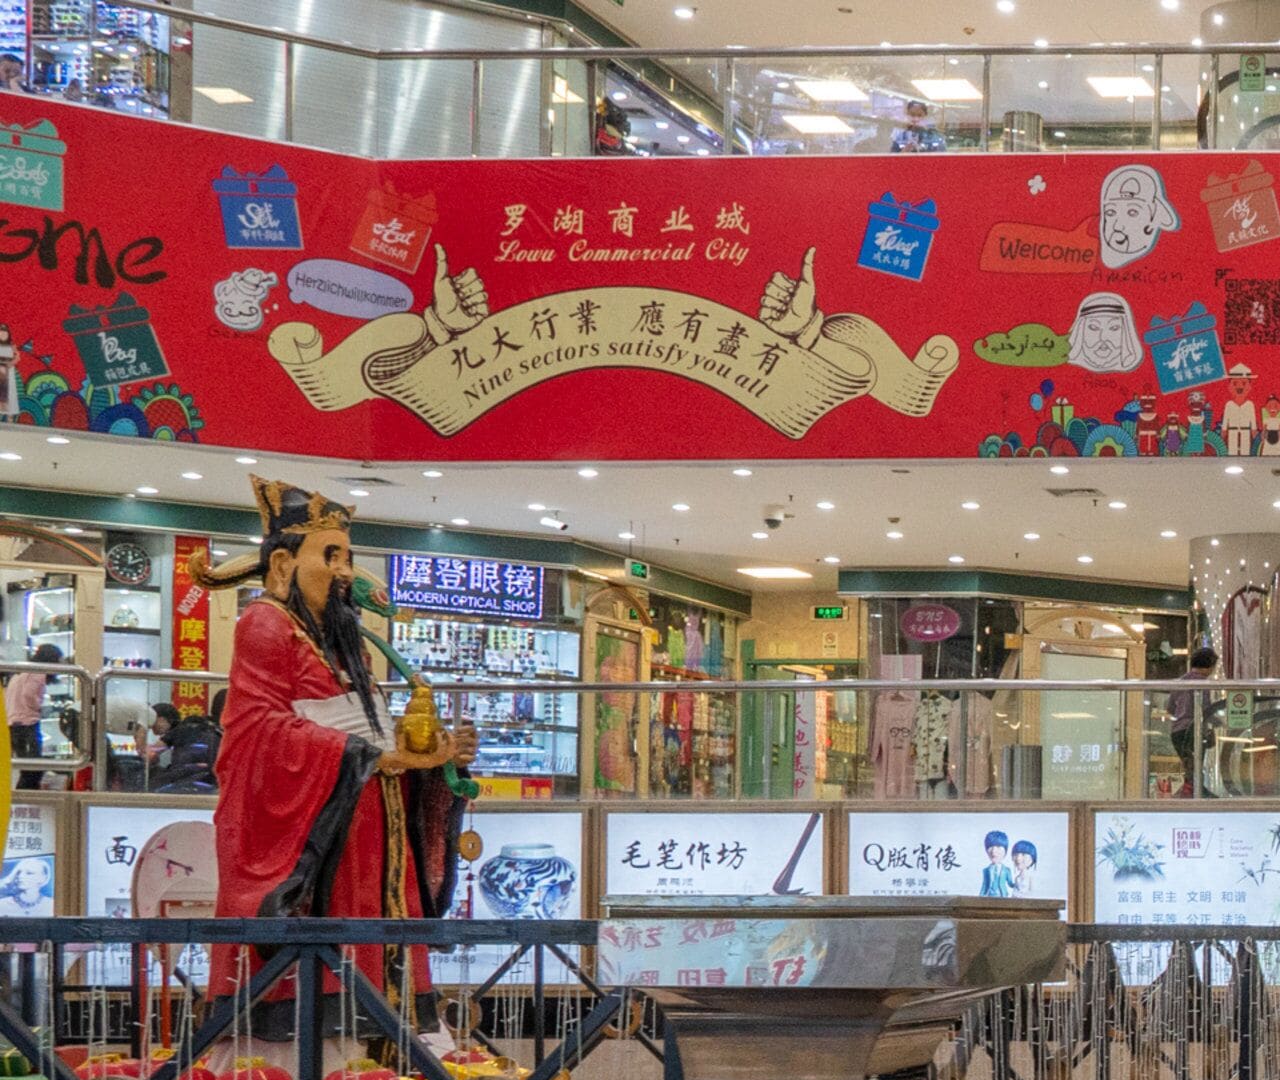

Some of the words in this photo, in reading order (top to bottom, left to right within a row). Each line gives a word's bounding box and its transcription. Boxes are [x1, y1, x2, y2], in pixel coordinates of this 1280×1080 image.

[500, 202, 750, 237] 罗湖商业城
[495, 240, 556, 262] Lowu
[569, 239, 695, 261] Commercial
[705, 238, 750, 266] City
[999, 237, 1093, 263] Welcome
[451, 300, 602, 378] 九大行業
[631, 300, 788, 376] 應有盡有
[462, 364, 514, 408] Nine
[519, 341, 600, 374] sectors
[608, 339, 690, 364] satisfy
[691, 352, 731, 378] you
[734, 373, 769, 398] all
[399, 555, 535, 598] 摩登眼镜
[396, 589, 448, 604] MODERN
[450, 594, 501, 610] OPTICAL
[503, 599, 536, 613] SHOP
[106, 836, 137, 867] 面
[621, 840, 748, 872] 毛笔作坊
[863, 842, 962, 872] Q版肖像
[1118, 891, 1142, 902] 富强
[1152, 891, 1177, 902] 民主
[1187, 891, 1212, 902] 文明
[1221, 891, 1247, 902] 和谐
